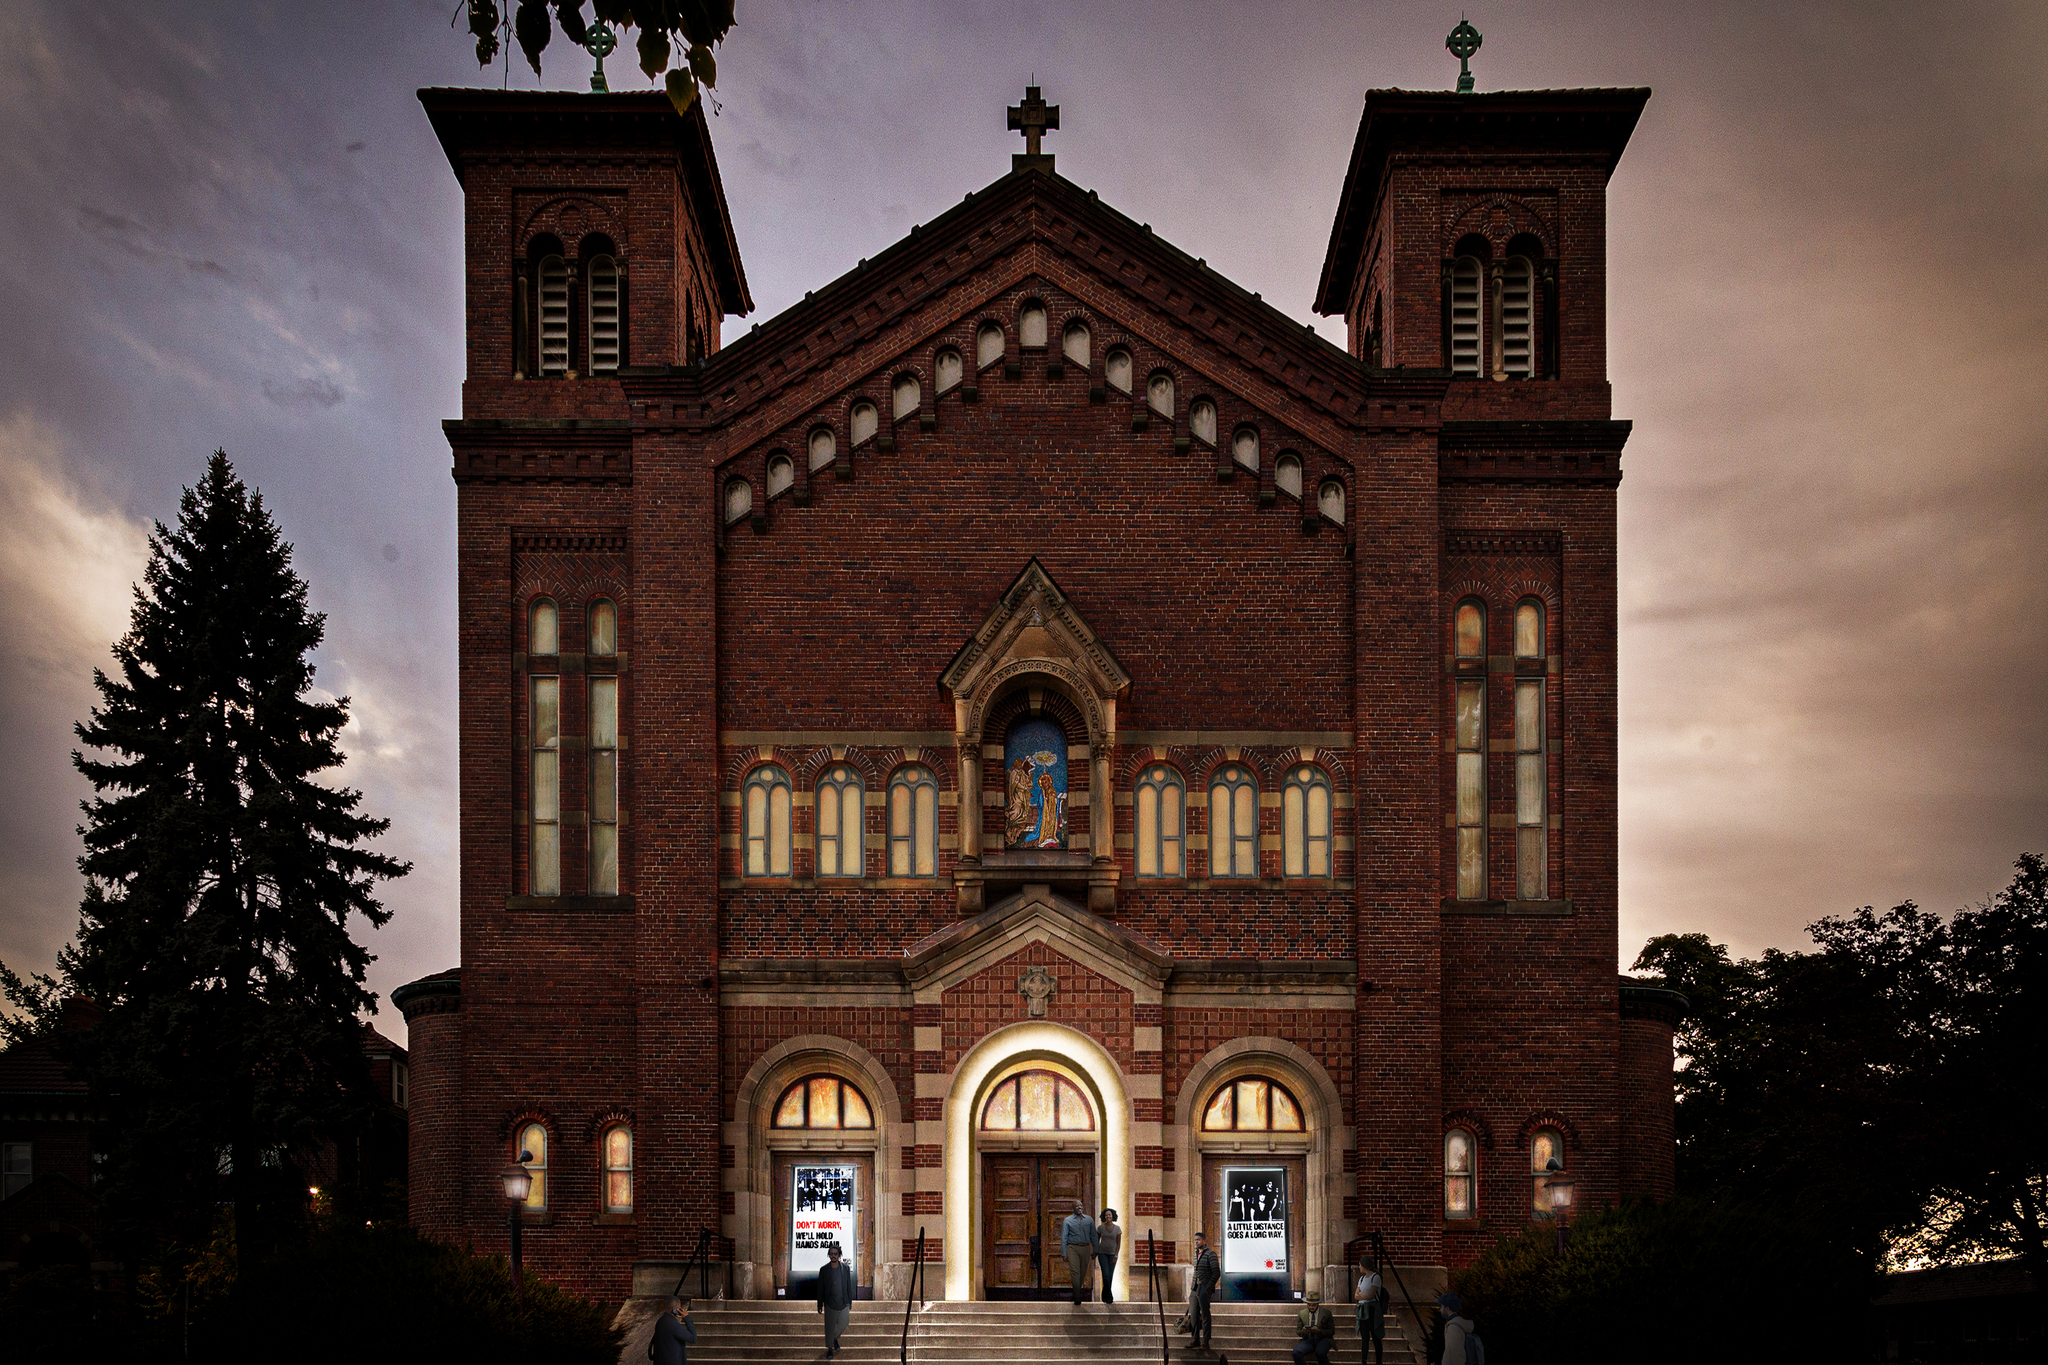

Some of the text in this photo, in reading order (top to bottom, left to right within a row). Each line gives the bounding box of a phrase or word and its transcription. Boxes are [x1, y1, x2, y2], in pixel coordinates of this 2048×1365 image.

[796, 1221, 842, 1230] DON'T WORRY,
[796, 1232, 834, 1240] WE'LL HOLD
[1227, 1231, 1244, 1239] GOES
[796, 1241, 819, 1249] HANDS
